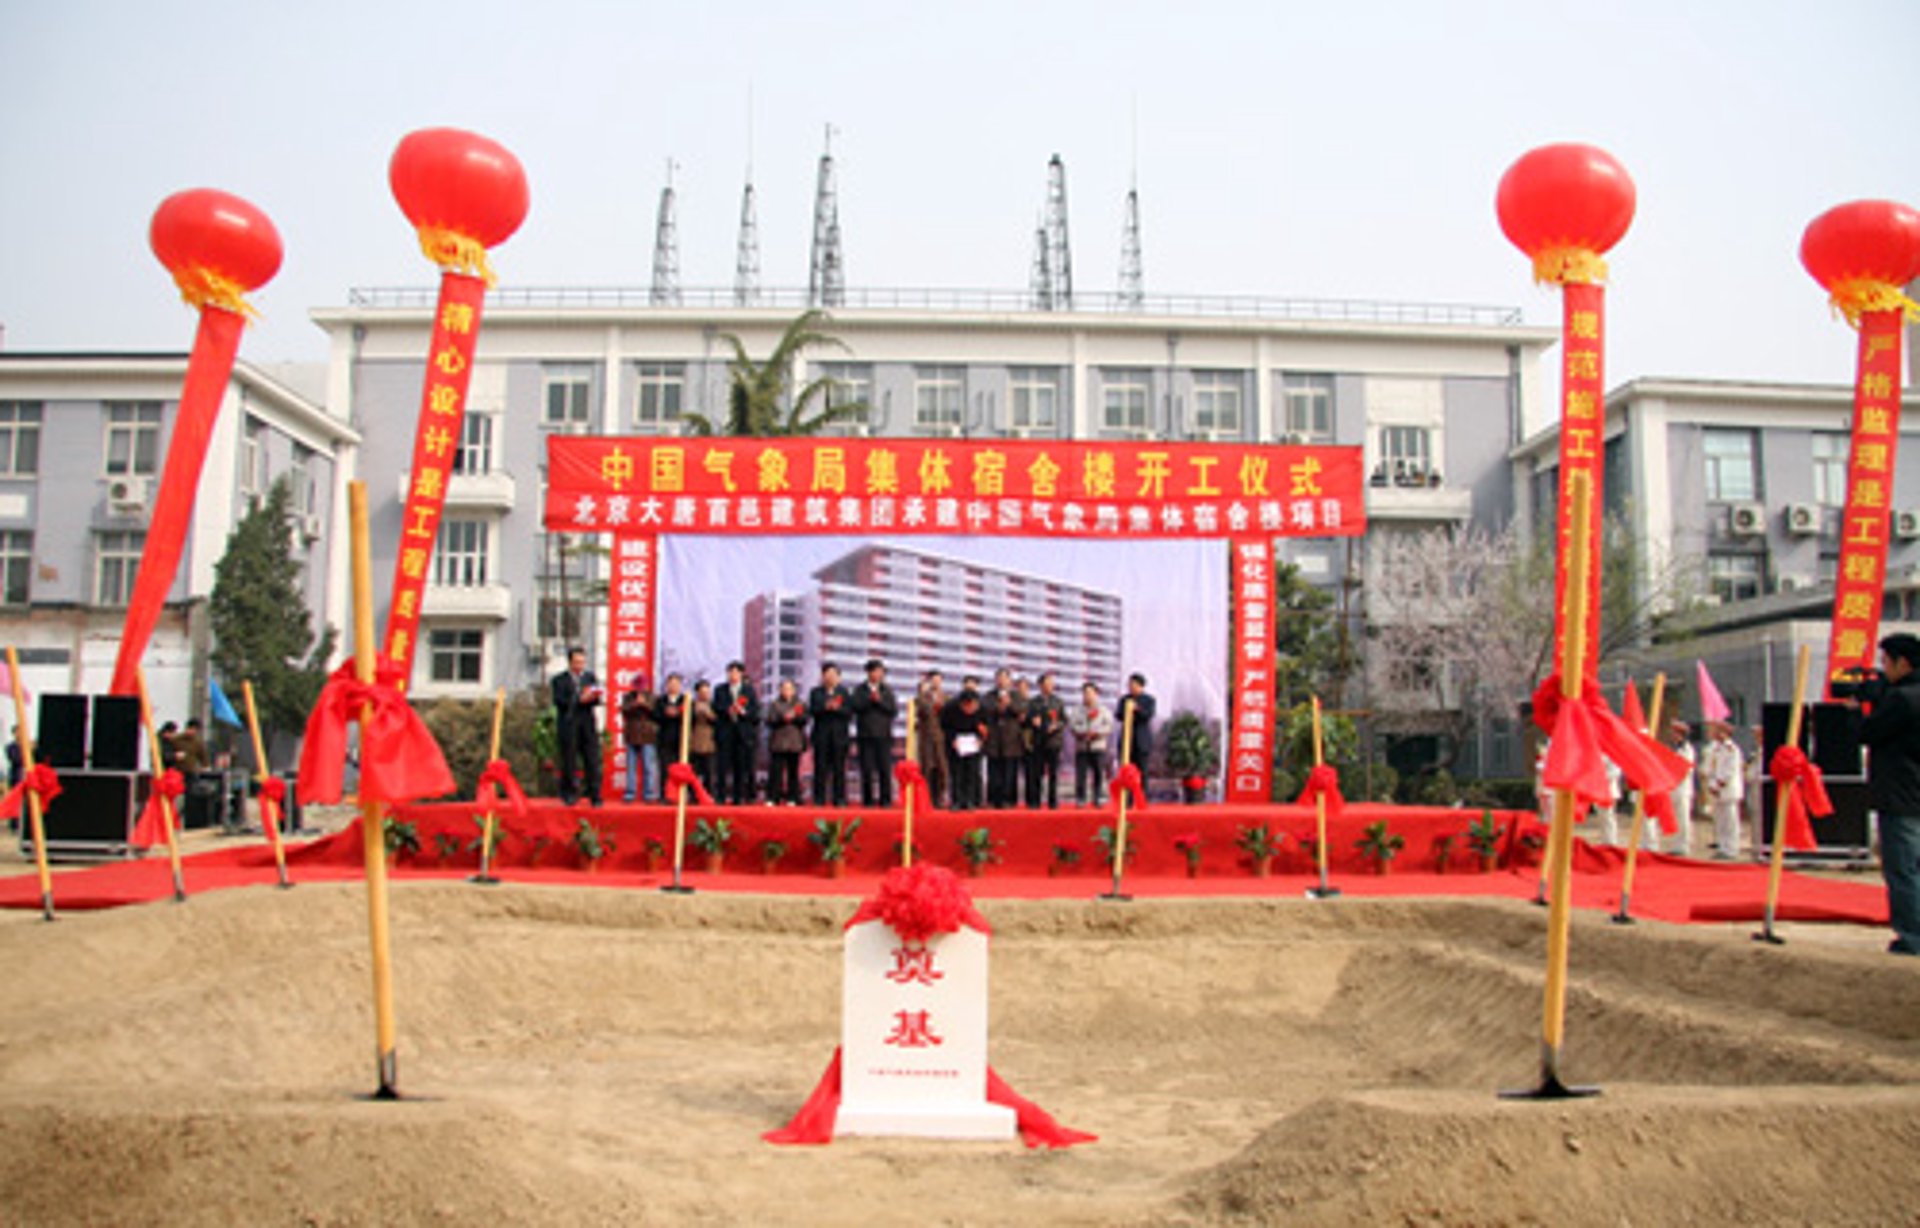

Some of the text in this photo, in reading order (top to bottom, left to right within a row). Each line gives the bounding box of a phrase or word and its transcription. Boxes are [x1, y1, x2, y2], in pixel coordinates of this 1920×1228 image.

[601, 445, 1323, 497] 中国气象局集体宿舍楼开工仪式
[883, 946, 945, 1048] 奠基
